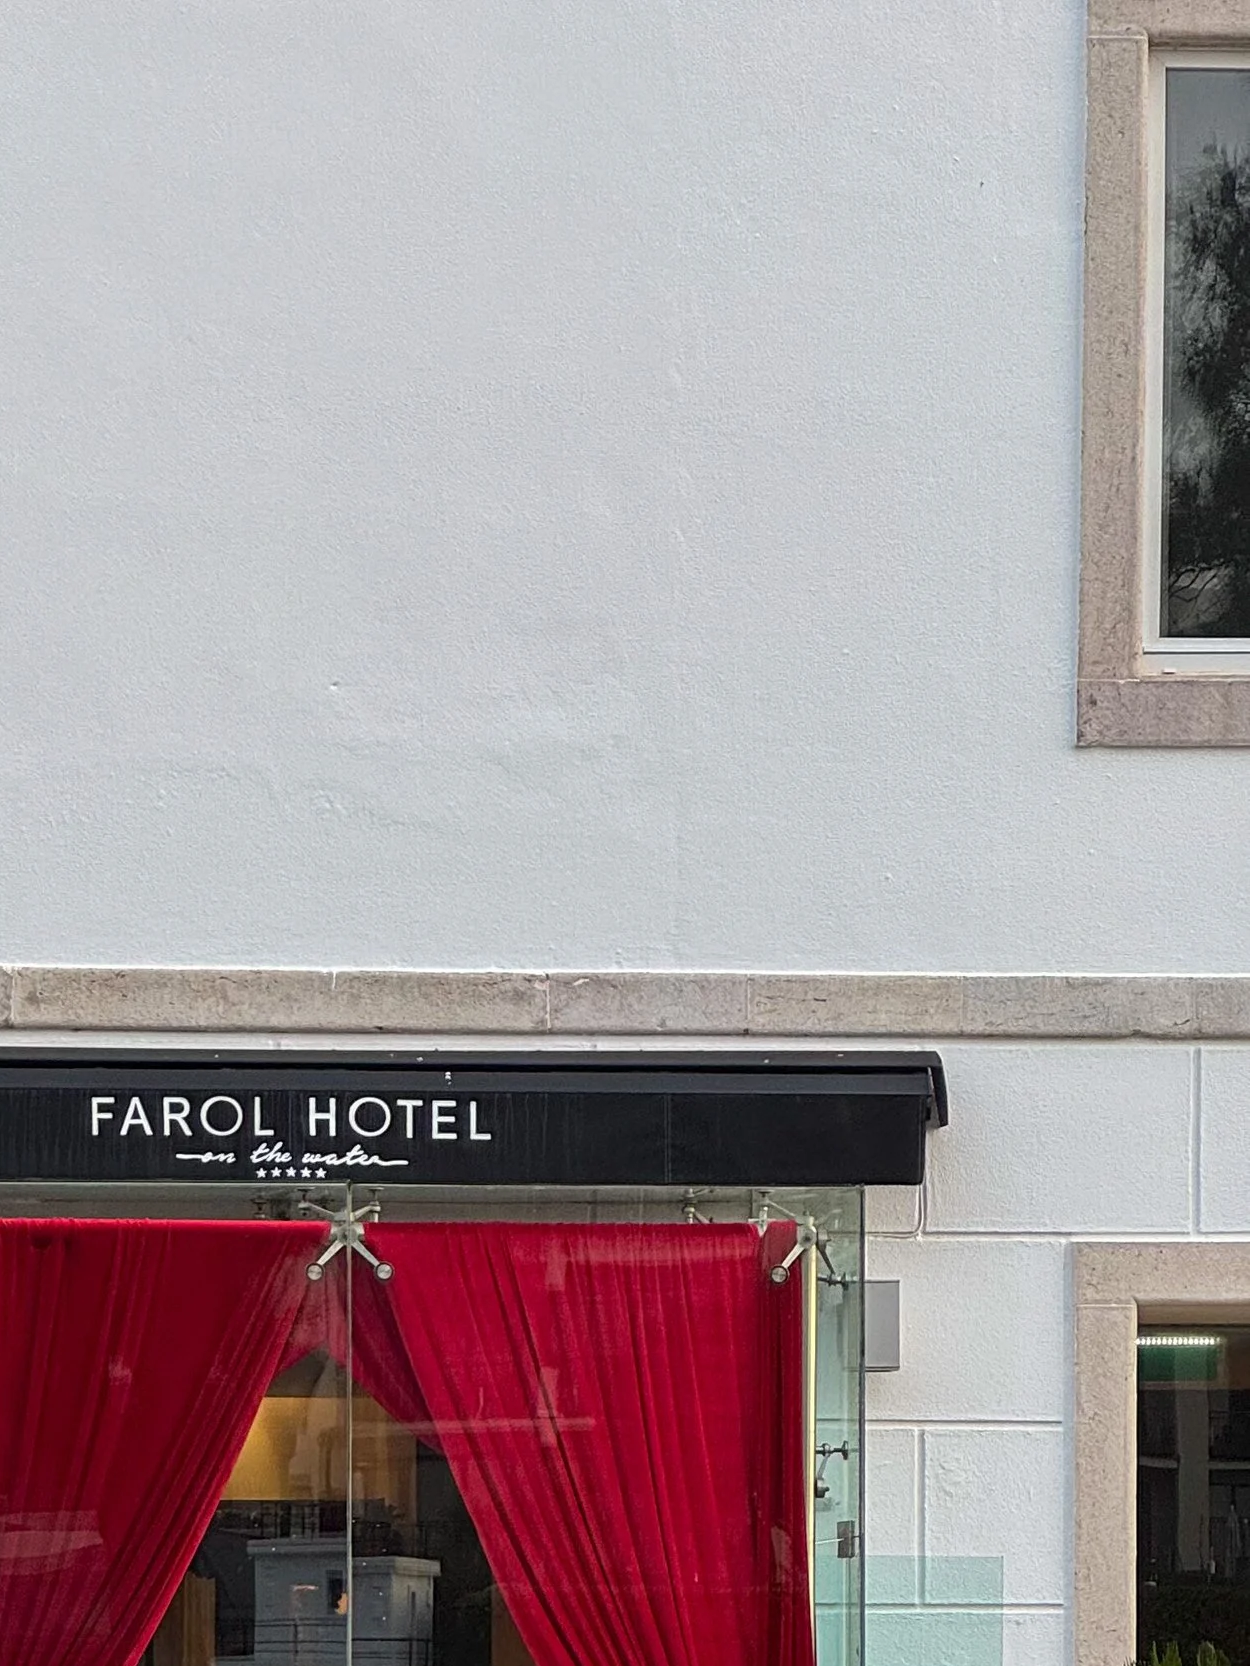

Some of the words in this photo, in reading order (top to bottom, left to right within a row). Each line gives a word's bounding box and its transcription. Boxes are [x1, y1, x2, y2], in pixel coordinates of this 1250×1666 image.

[91, 1095, 275, 1136] FAROL
[308, 1096, 493, 1141] HOTEL
[176, 1151, 236, 1164] on
[250, 1141, 293, 1164] the
[301, 1144, 409, 1166] water
